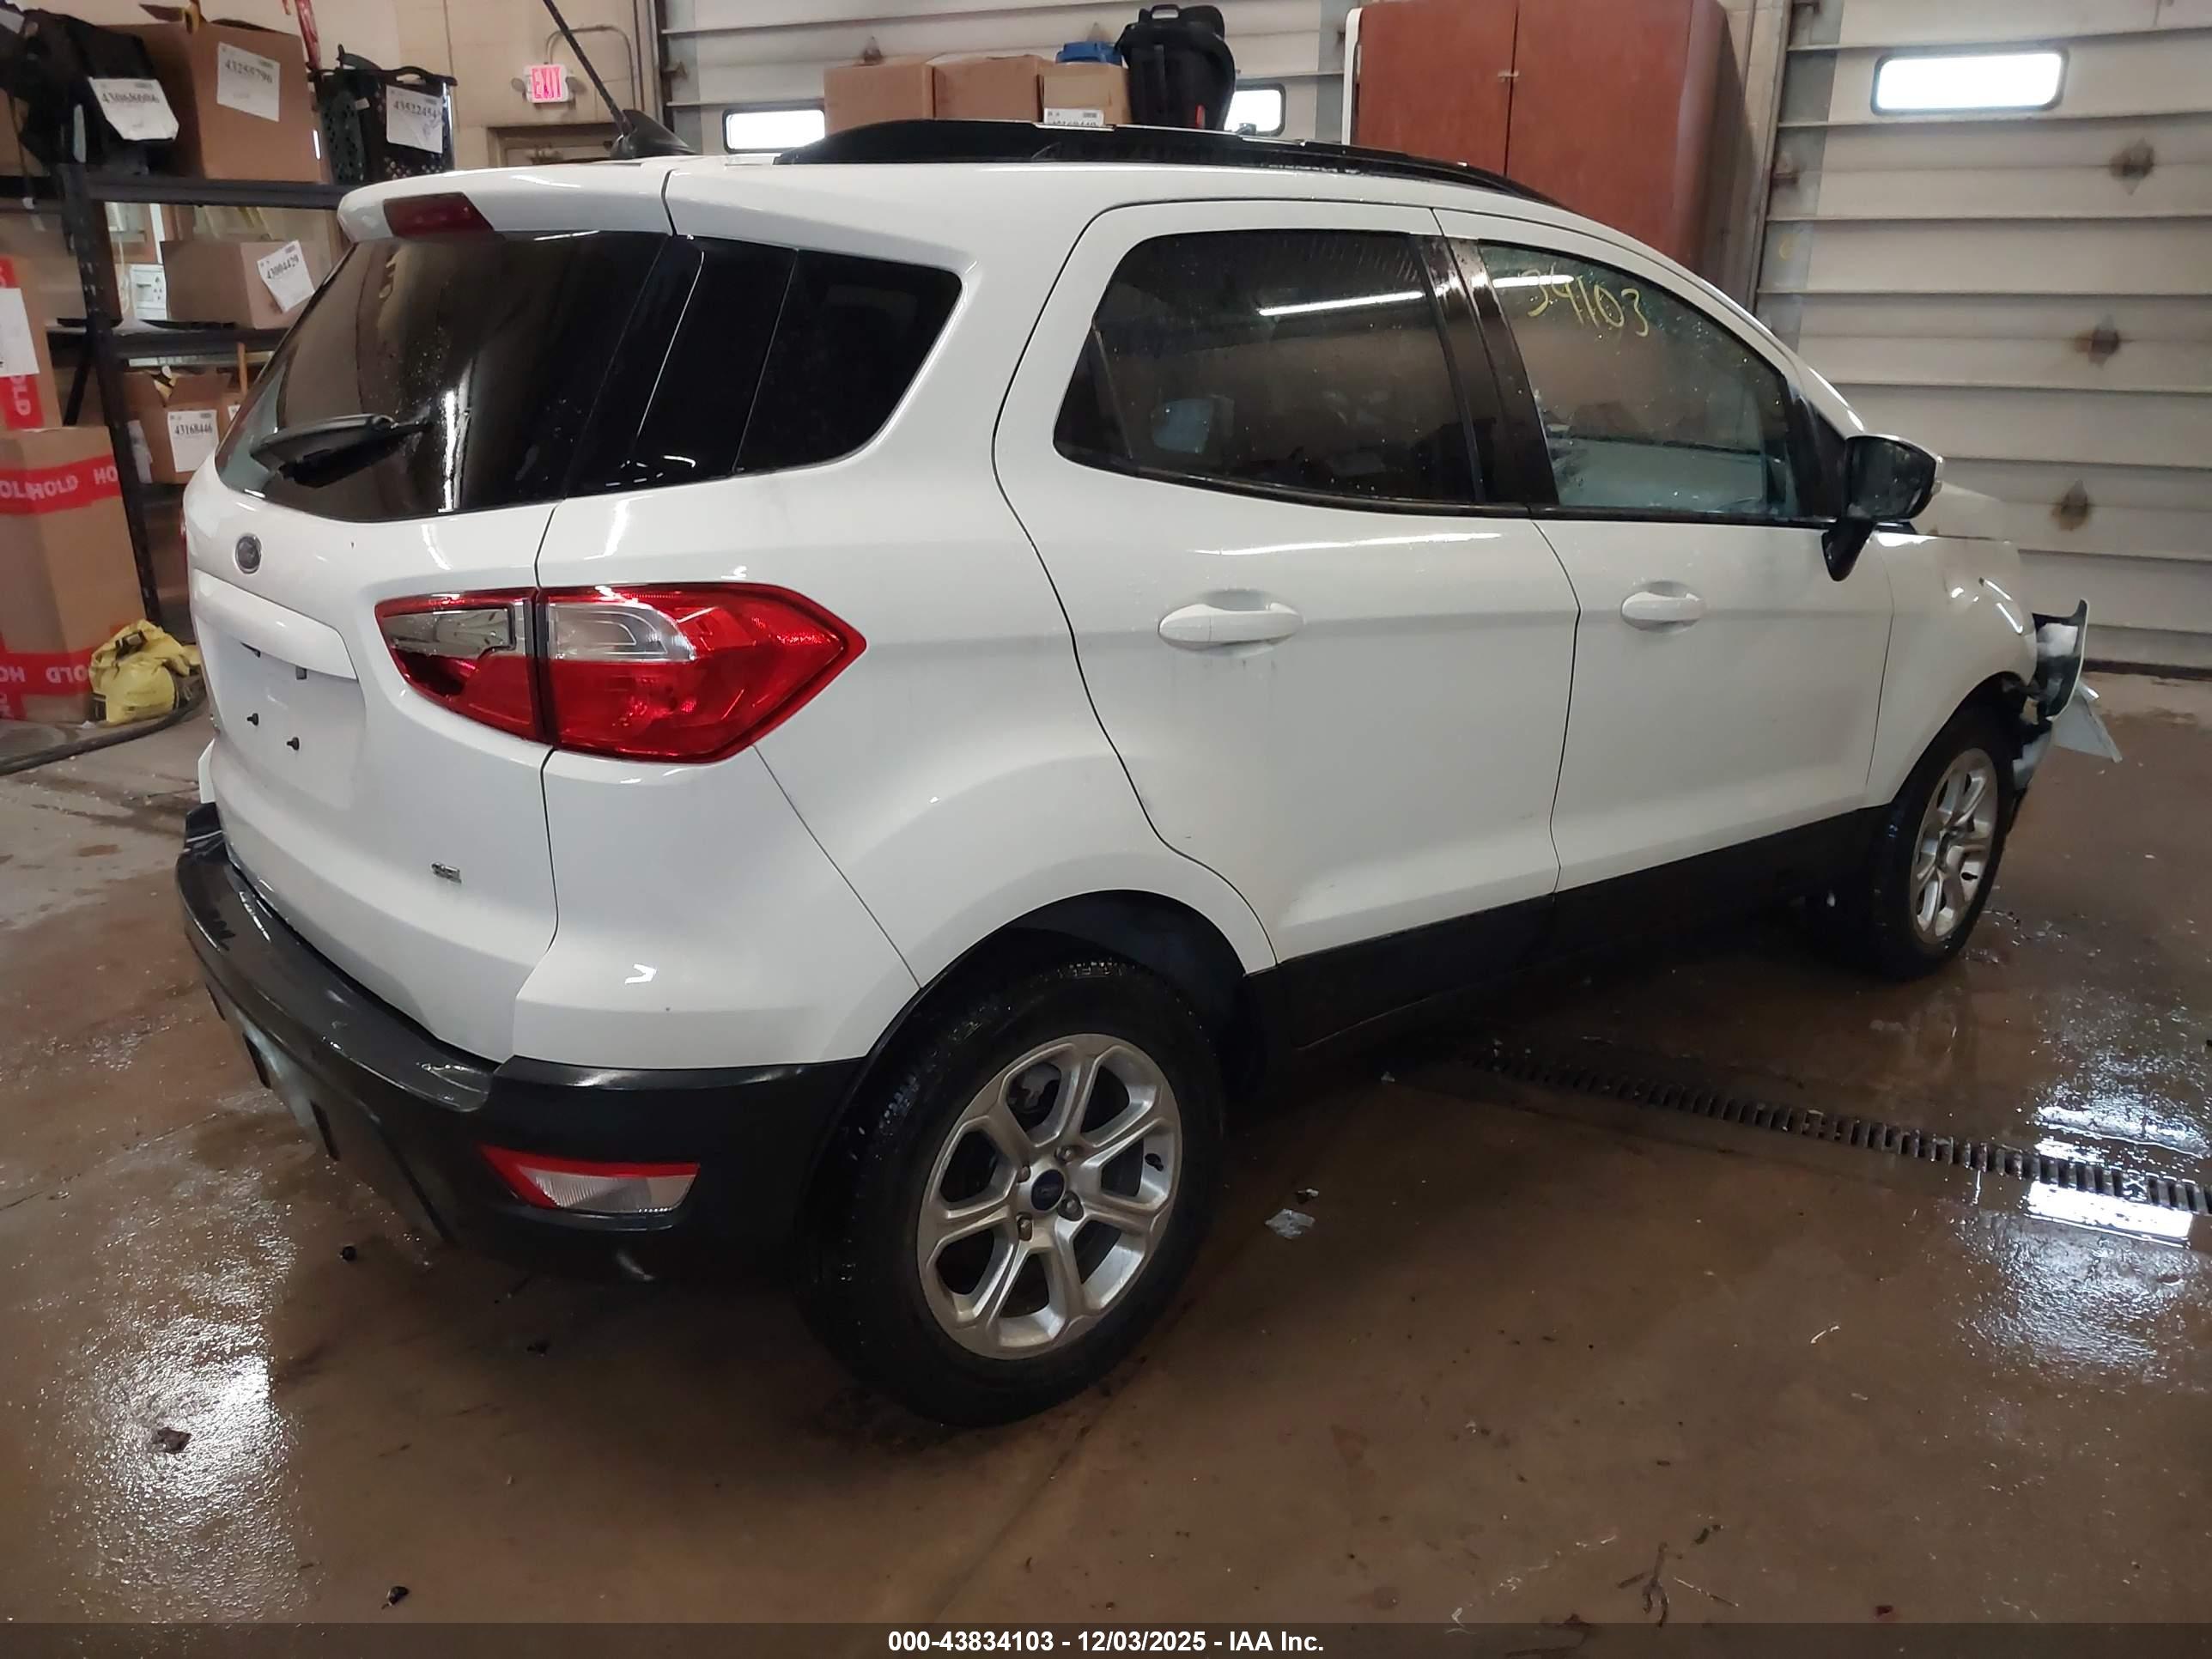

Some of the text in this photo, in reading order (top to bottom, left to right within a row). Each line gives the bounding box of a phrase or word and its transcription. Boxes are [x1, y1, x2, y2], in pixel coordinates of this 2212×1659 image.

[531, 66, 562, 99] EXIT
[1519, 258, 1650, 337] 34103
[24, 474, 79, 501] HOLD
